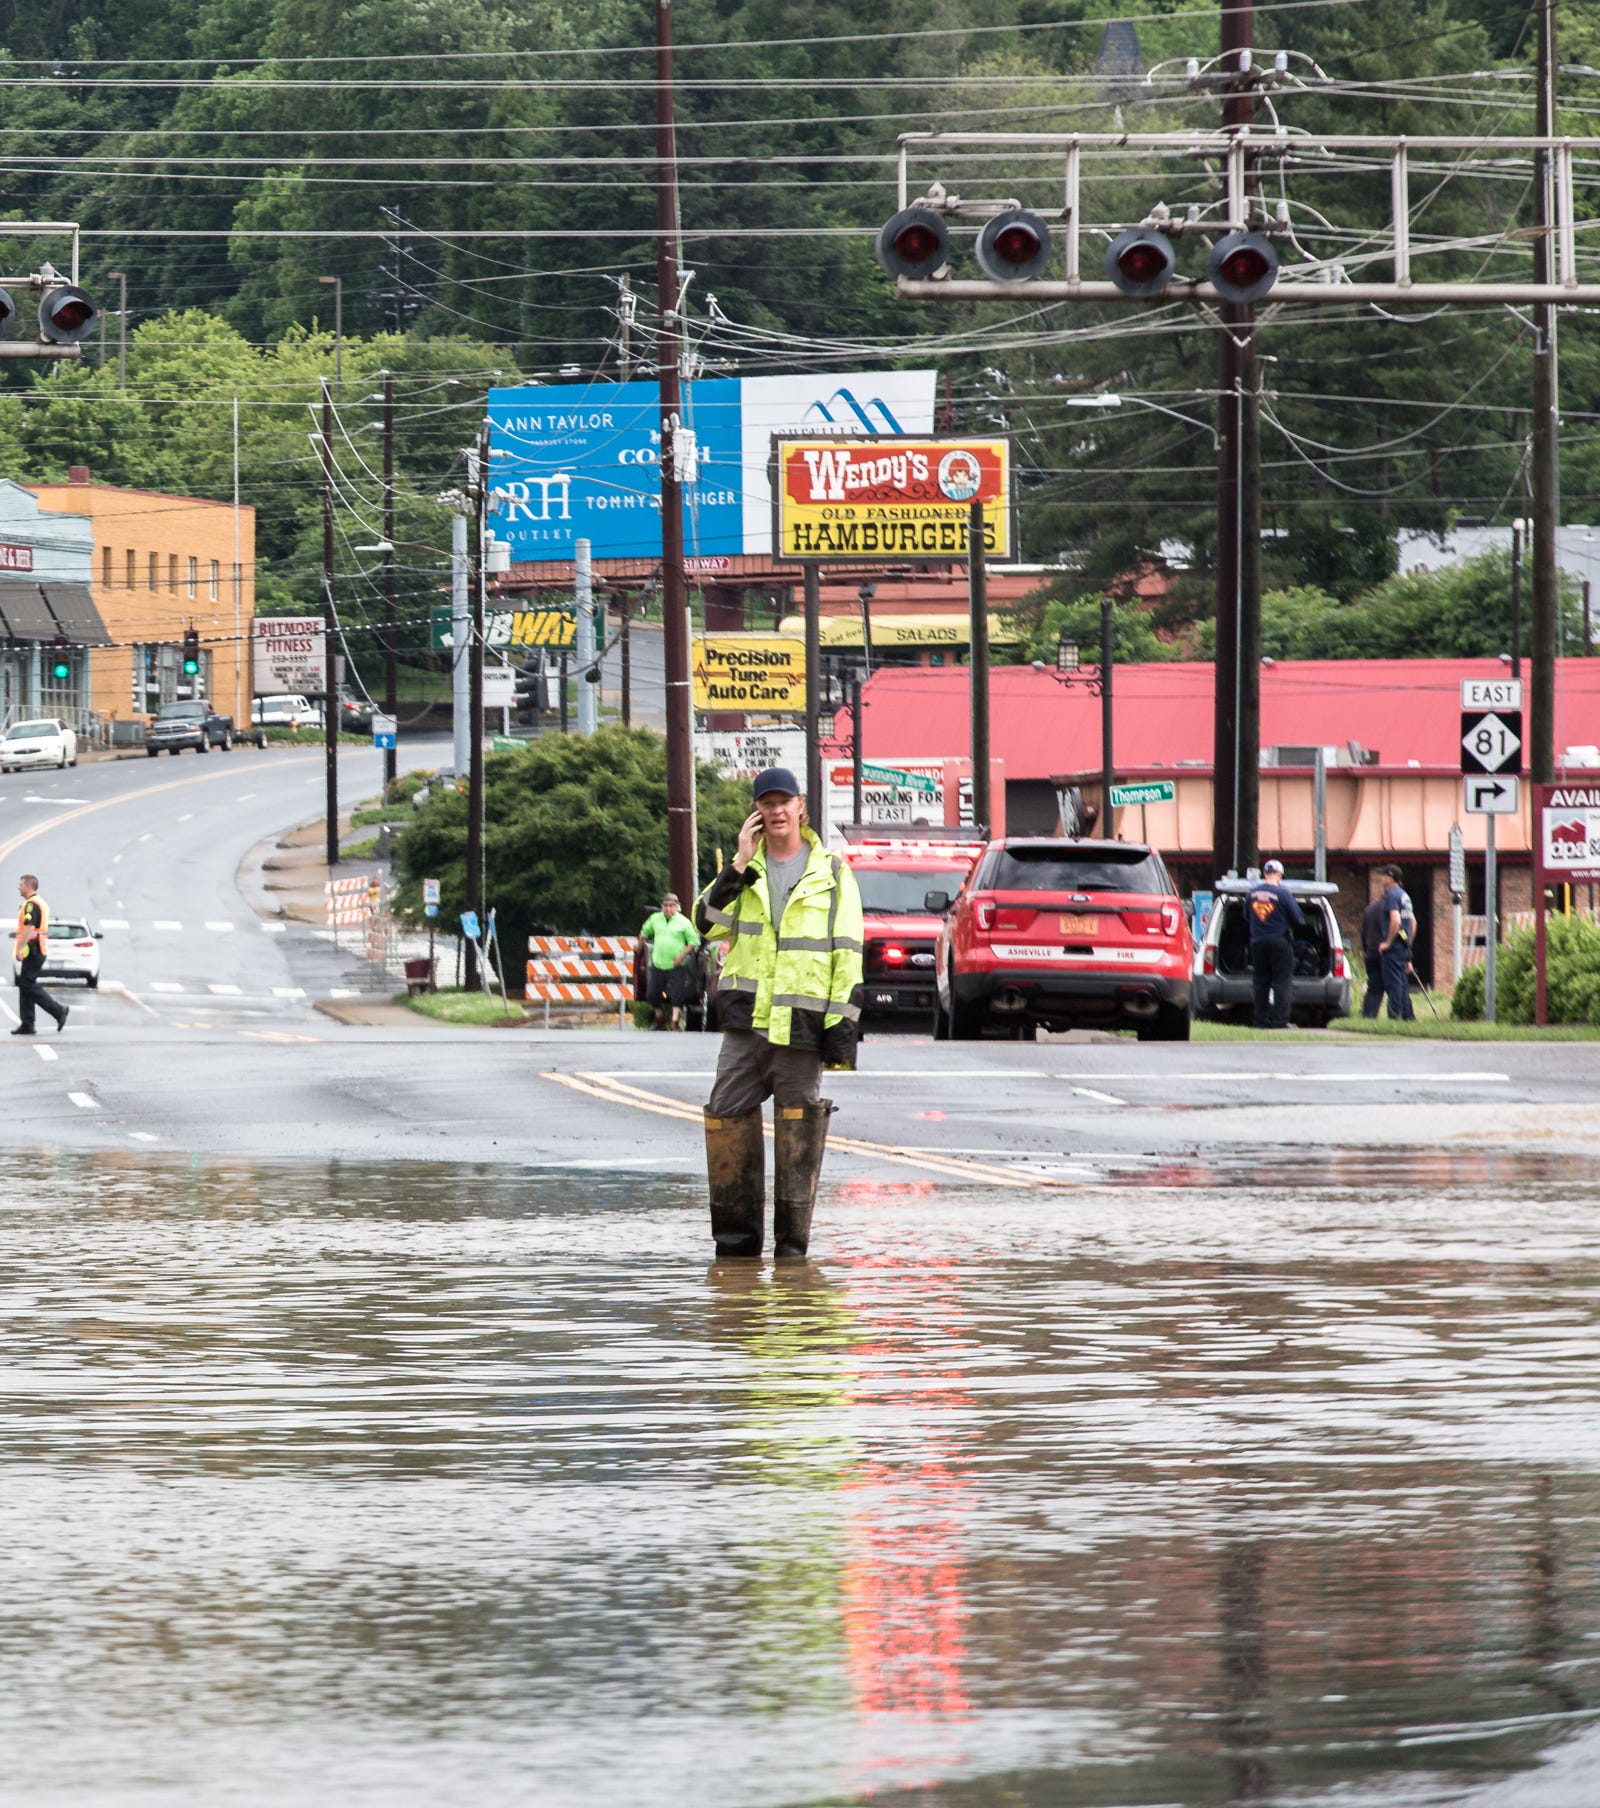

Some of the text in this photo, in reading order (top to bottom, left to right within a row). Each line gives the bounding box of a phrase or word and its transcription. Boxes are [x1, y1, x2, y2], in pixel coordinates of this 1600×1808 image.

[505, 413, 614, 432] ANN TAYLOR
[506, 476, 572, 522] RH
[586, 495, 645, 510] TOMMY
[822, 507, 967, 520] OLD FASHIONED
[506, 529, 572, 541] OUTLET
[896, 628, 958, 642] SALADS
[266, 639, 312, 653] FITNESS
[706, 648, 791, 666] Precision
[729, 667, 768, 682] Tune
[708, 683, 789, 700] Auto Care
[1472, 686, 1513, 702] EAST
[1476, 729, 1507, 756] 81
[918, 791, 944, 803] FOR
[1113, 787, 1162, 804] Thompson
[877, 808, 905, 821] EAST
[1007, 948, 1136, 960] ASHEVILLE FIRE
